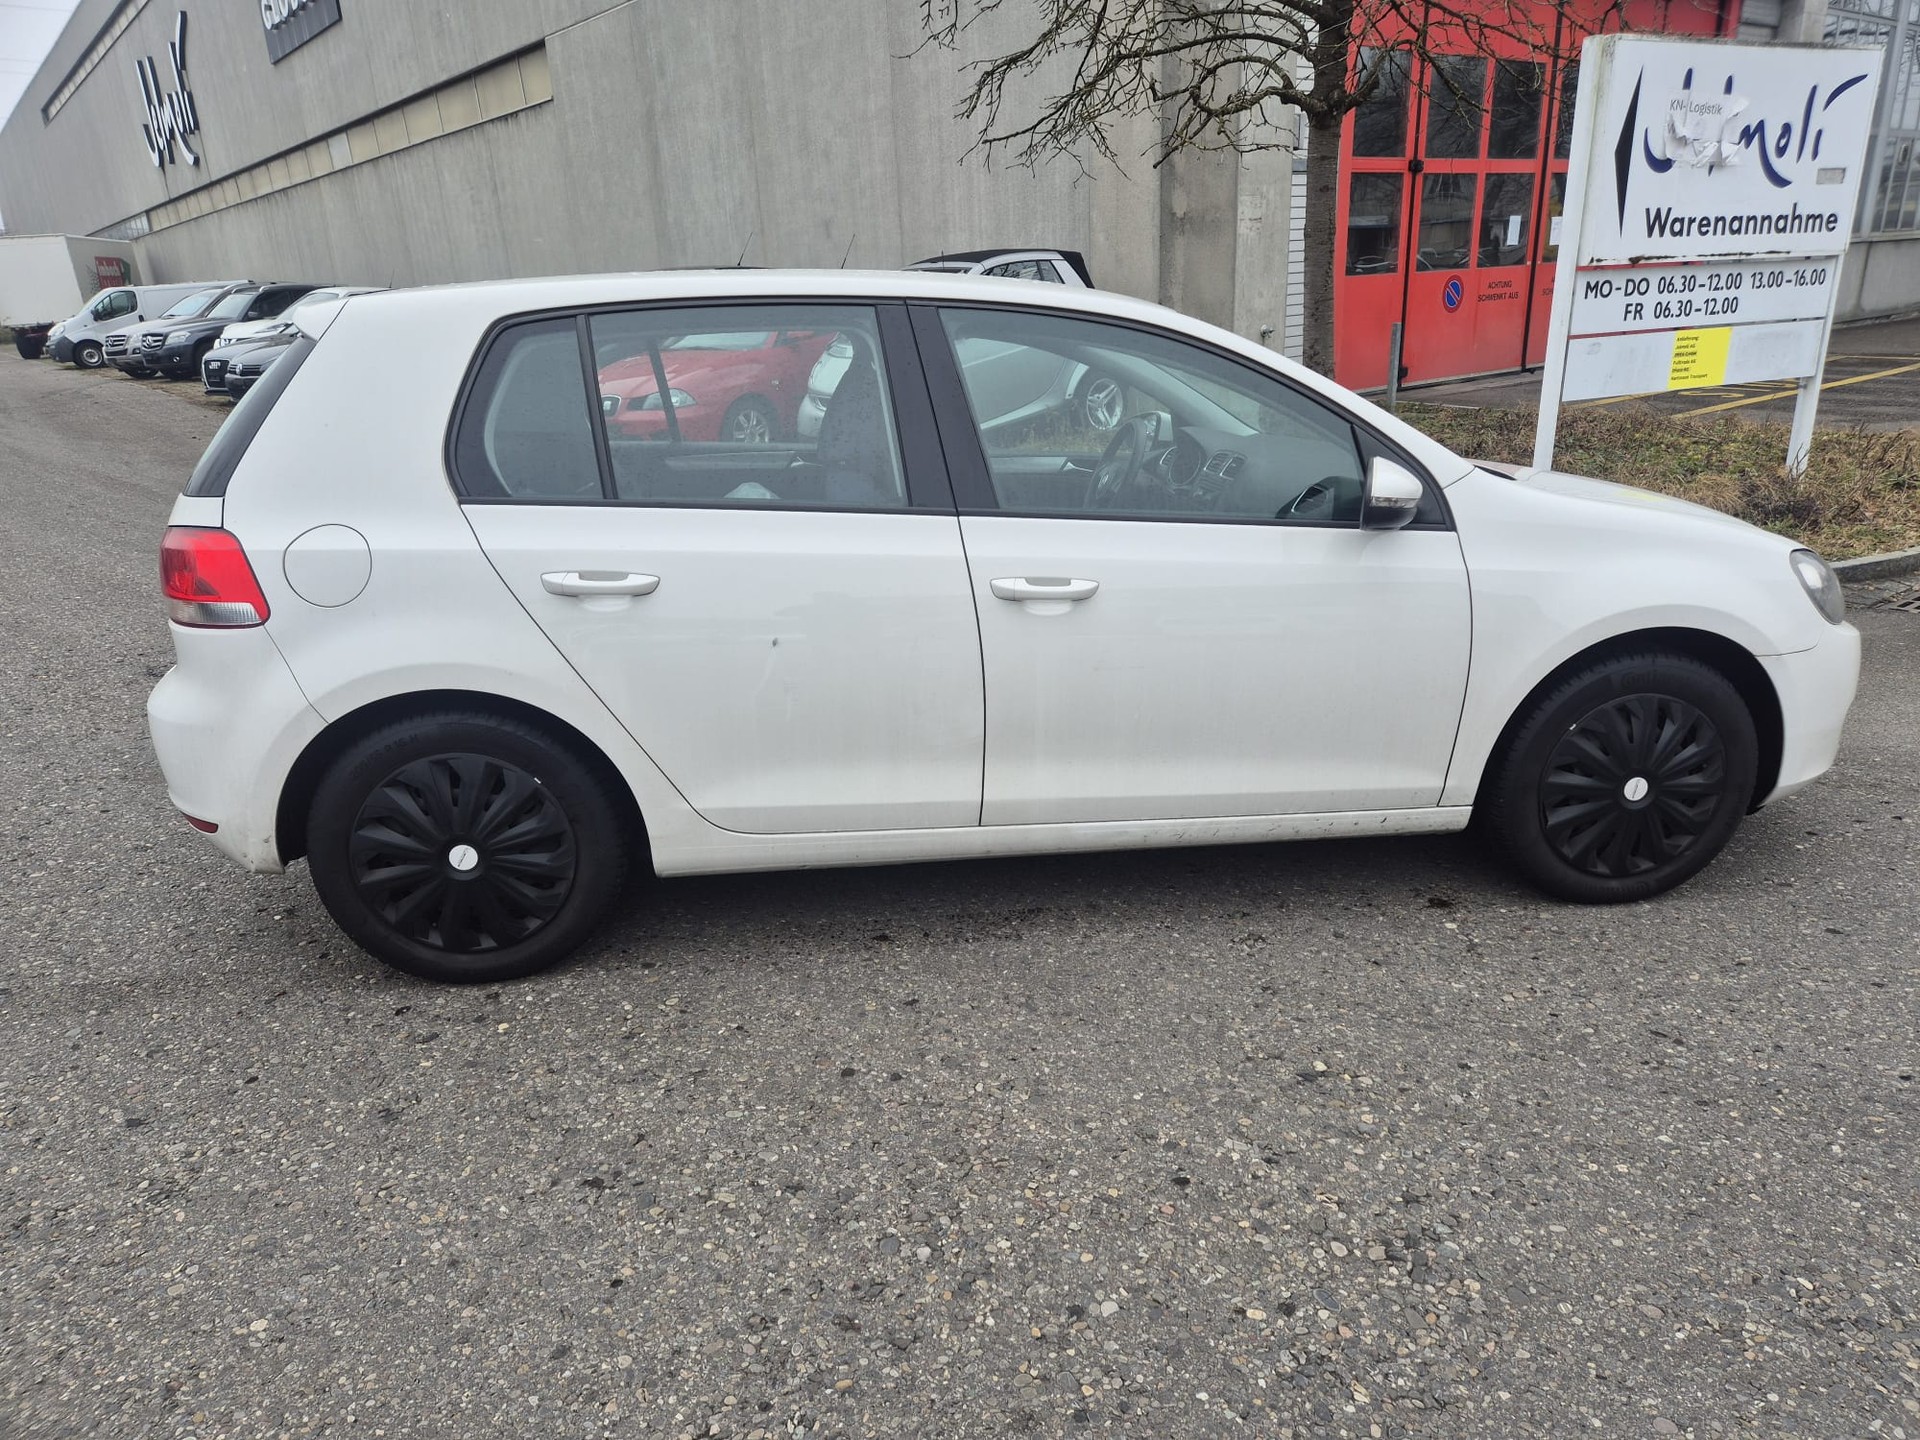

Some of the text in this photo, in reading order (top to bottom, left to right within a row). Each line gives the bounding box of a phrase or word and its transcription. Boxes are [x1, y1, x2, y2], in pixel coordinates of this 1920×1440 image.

[1645, 202, 1838, 239] Warenannahme
[1487, 280, 1512, 290] ACHTUNG
[1477, 291, 1519, 303] SCHWENKT AUS
[1623, 302, 1644, 322] FR
